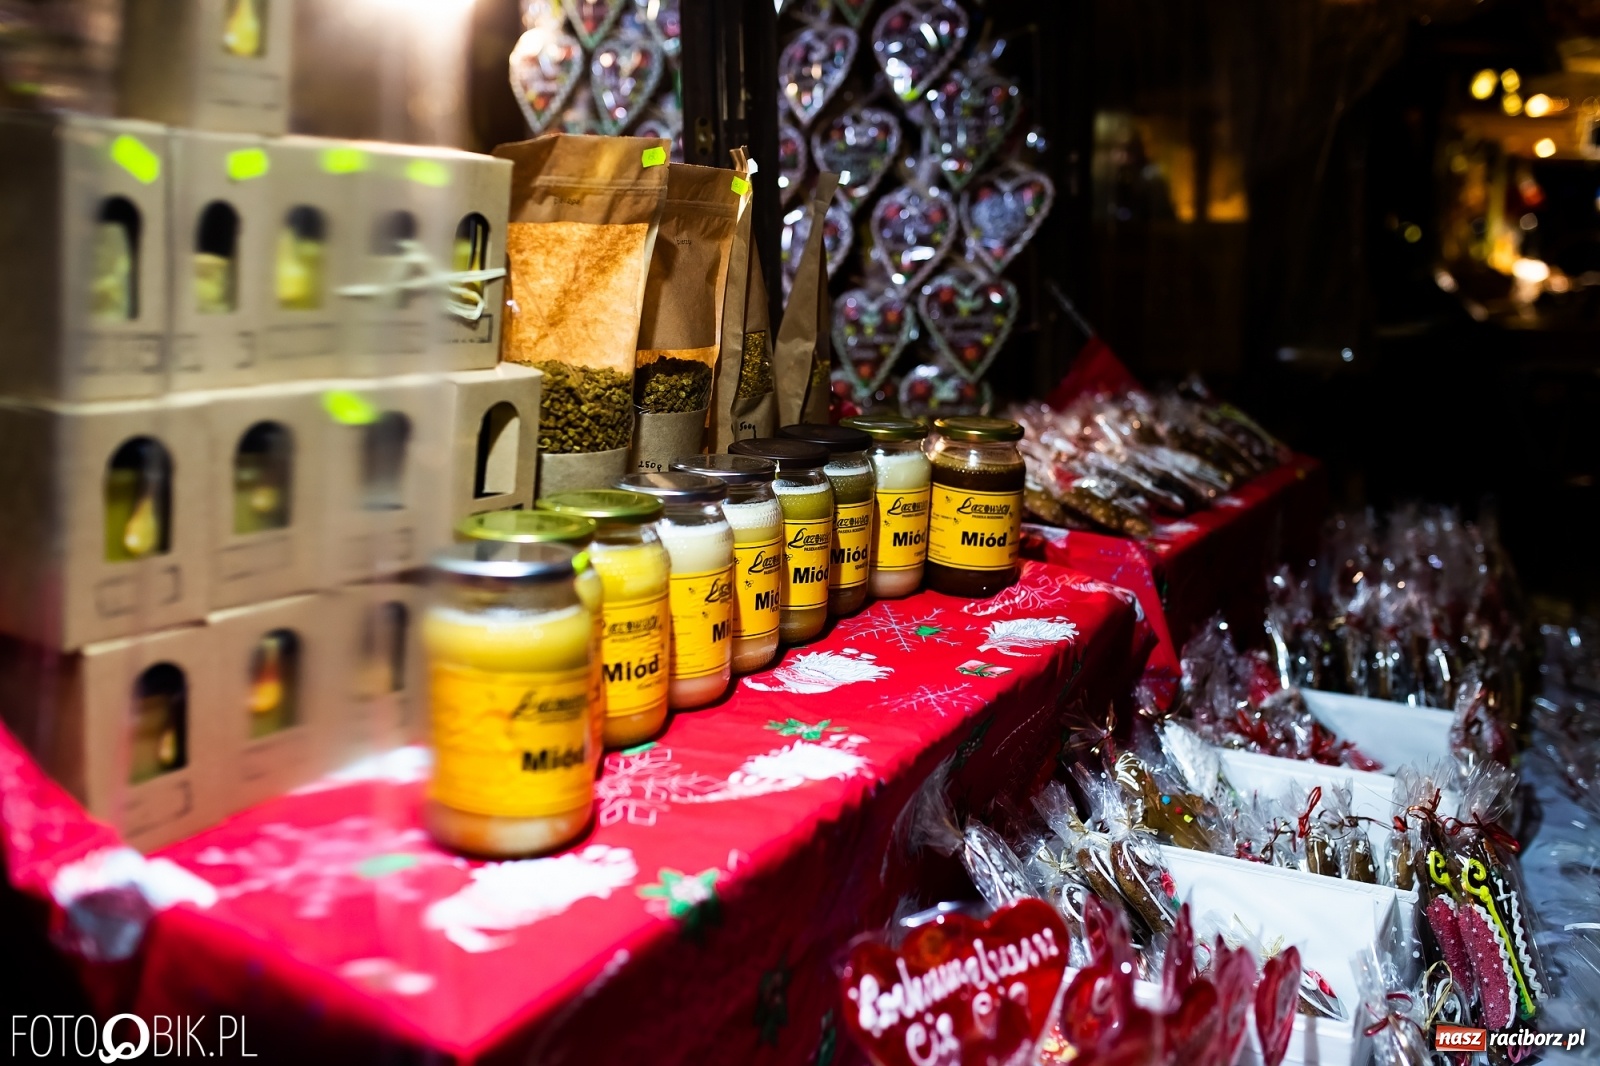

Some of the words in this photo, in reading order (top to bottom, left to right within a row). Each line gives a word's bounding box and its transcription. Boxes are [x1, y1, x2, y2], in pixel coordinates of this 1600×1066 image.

[961, 530, 1007, 547] Miód
[831, 544, 868, 564] Miód
[755, 586, 780, 611] Mió
[712, 618, 731, 643] Mi
[602, 653, 659, 682] Miód
